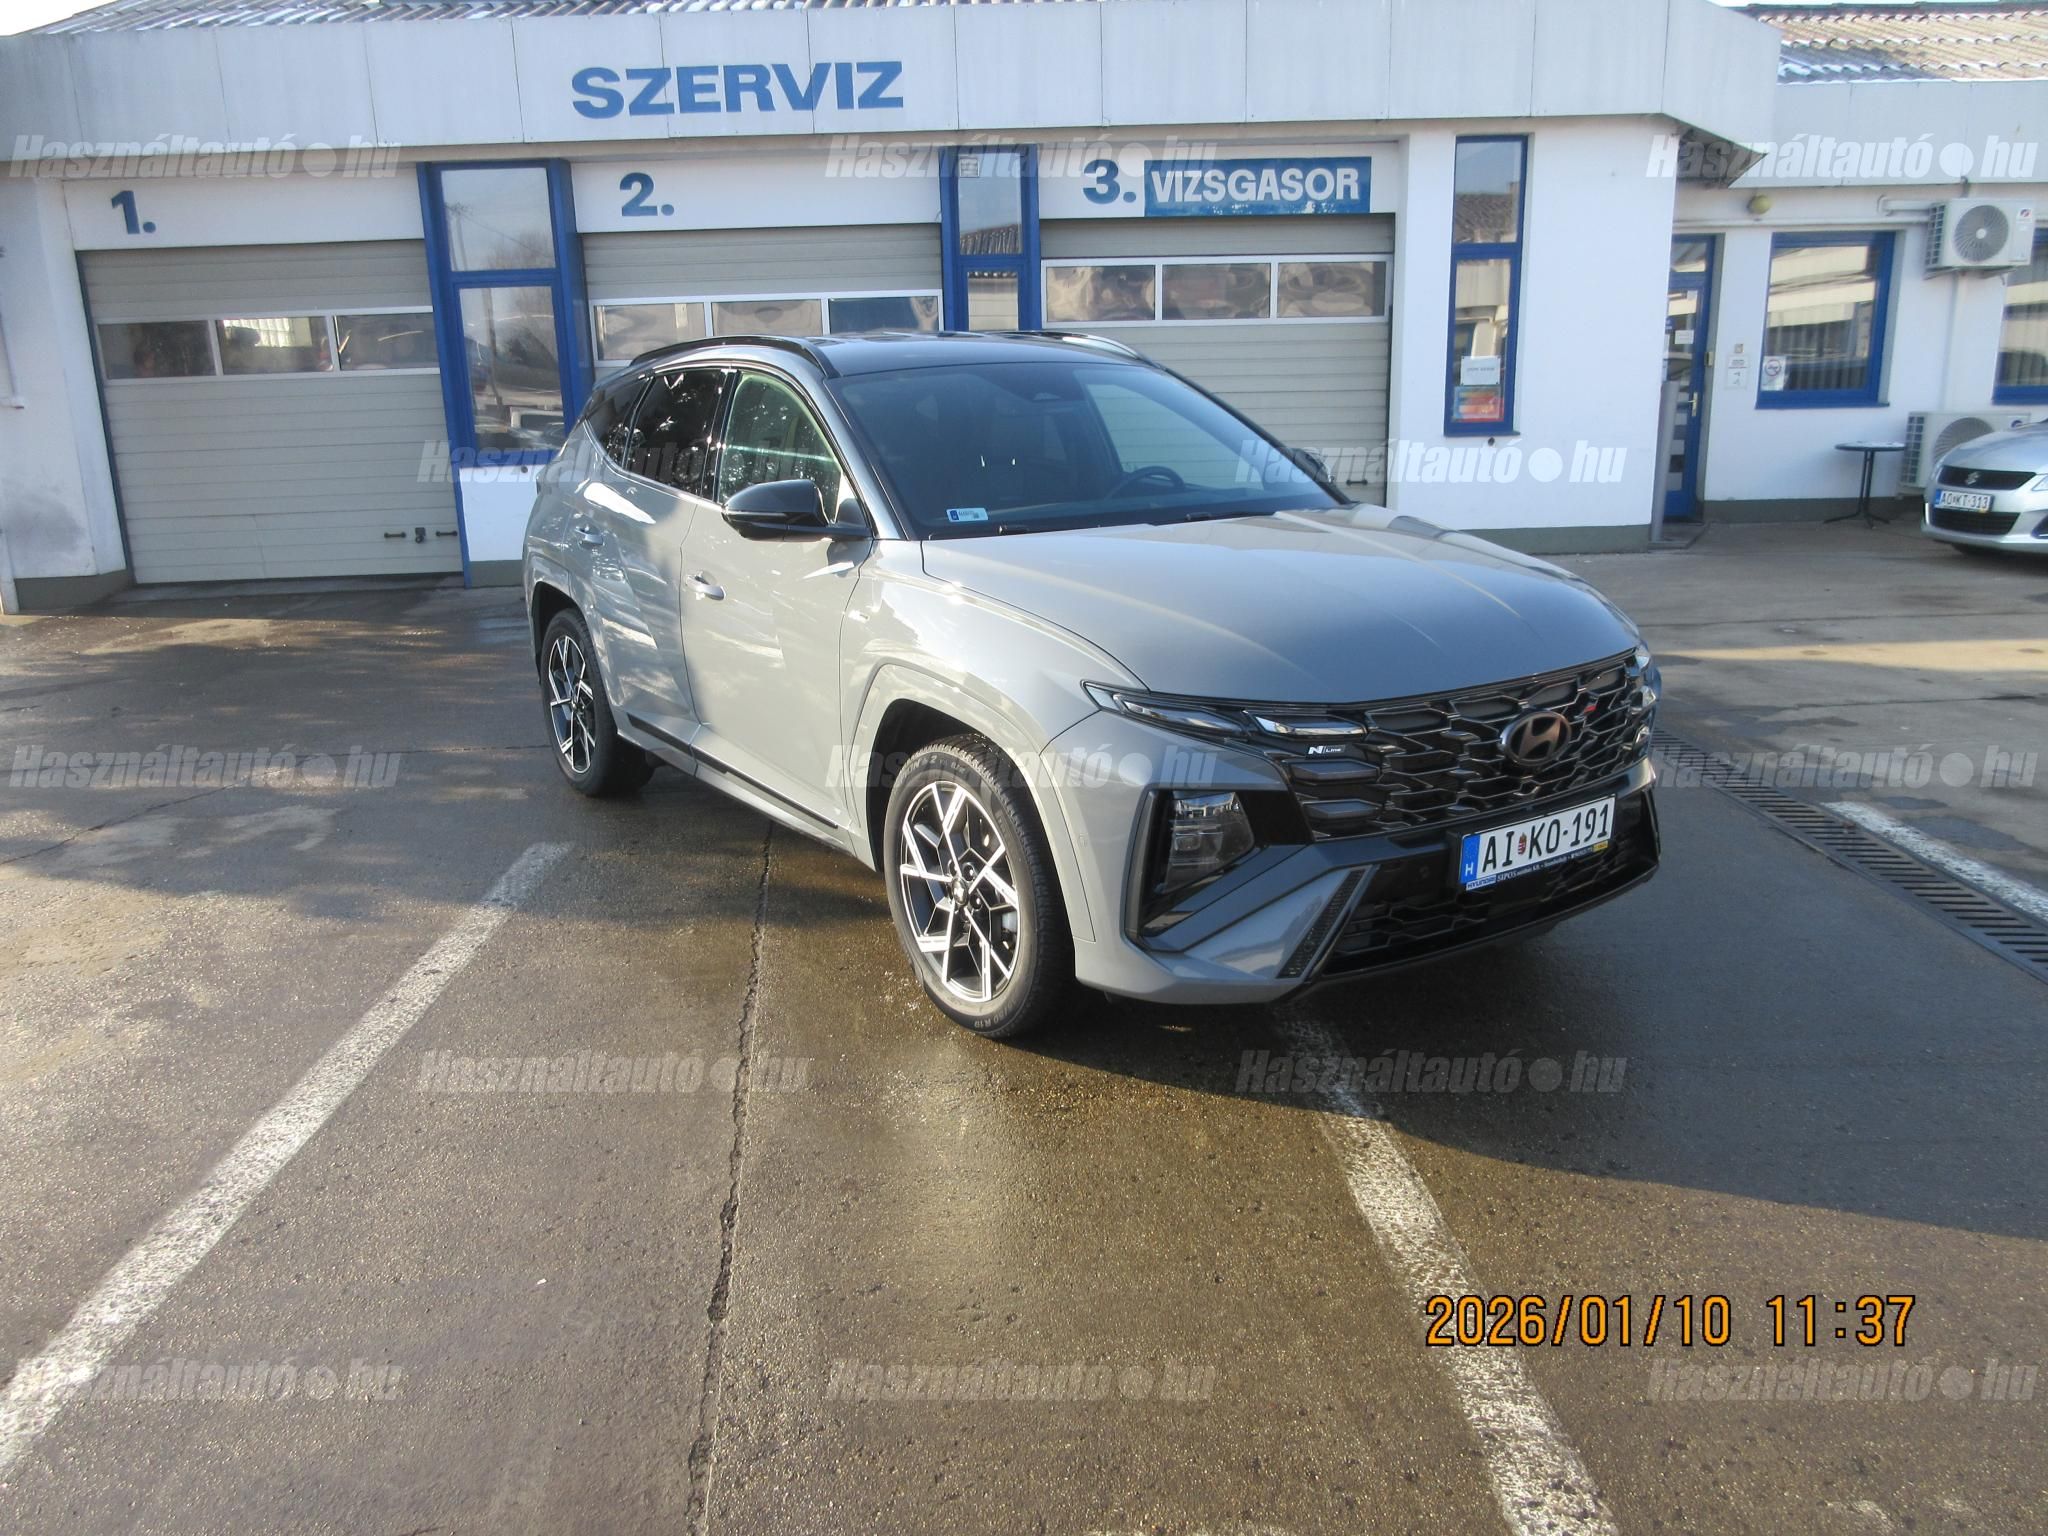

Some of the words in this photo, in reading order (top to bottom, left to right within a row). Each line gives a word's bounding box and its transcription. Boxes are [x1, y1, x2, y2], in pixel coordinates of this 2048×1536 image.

[572, 61, 904, 119] SZERVIZ
[620, 172, 675, 217] 2.
[1083, 160, 1137, 205] 3.
[1152, 166, 1361, 205] VIZSGASOR
[111, 190, 156, 235] 1.
